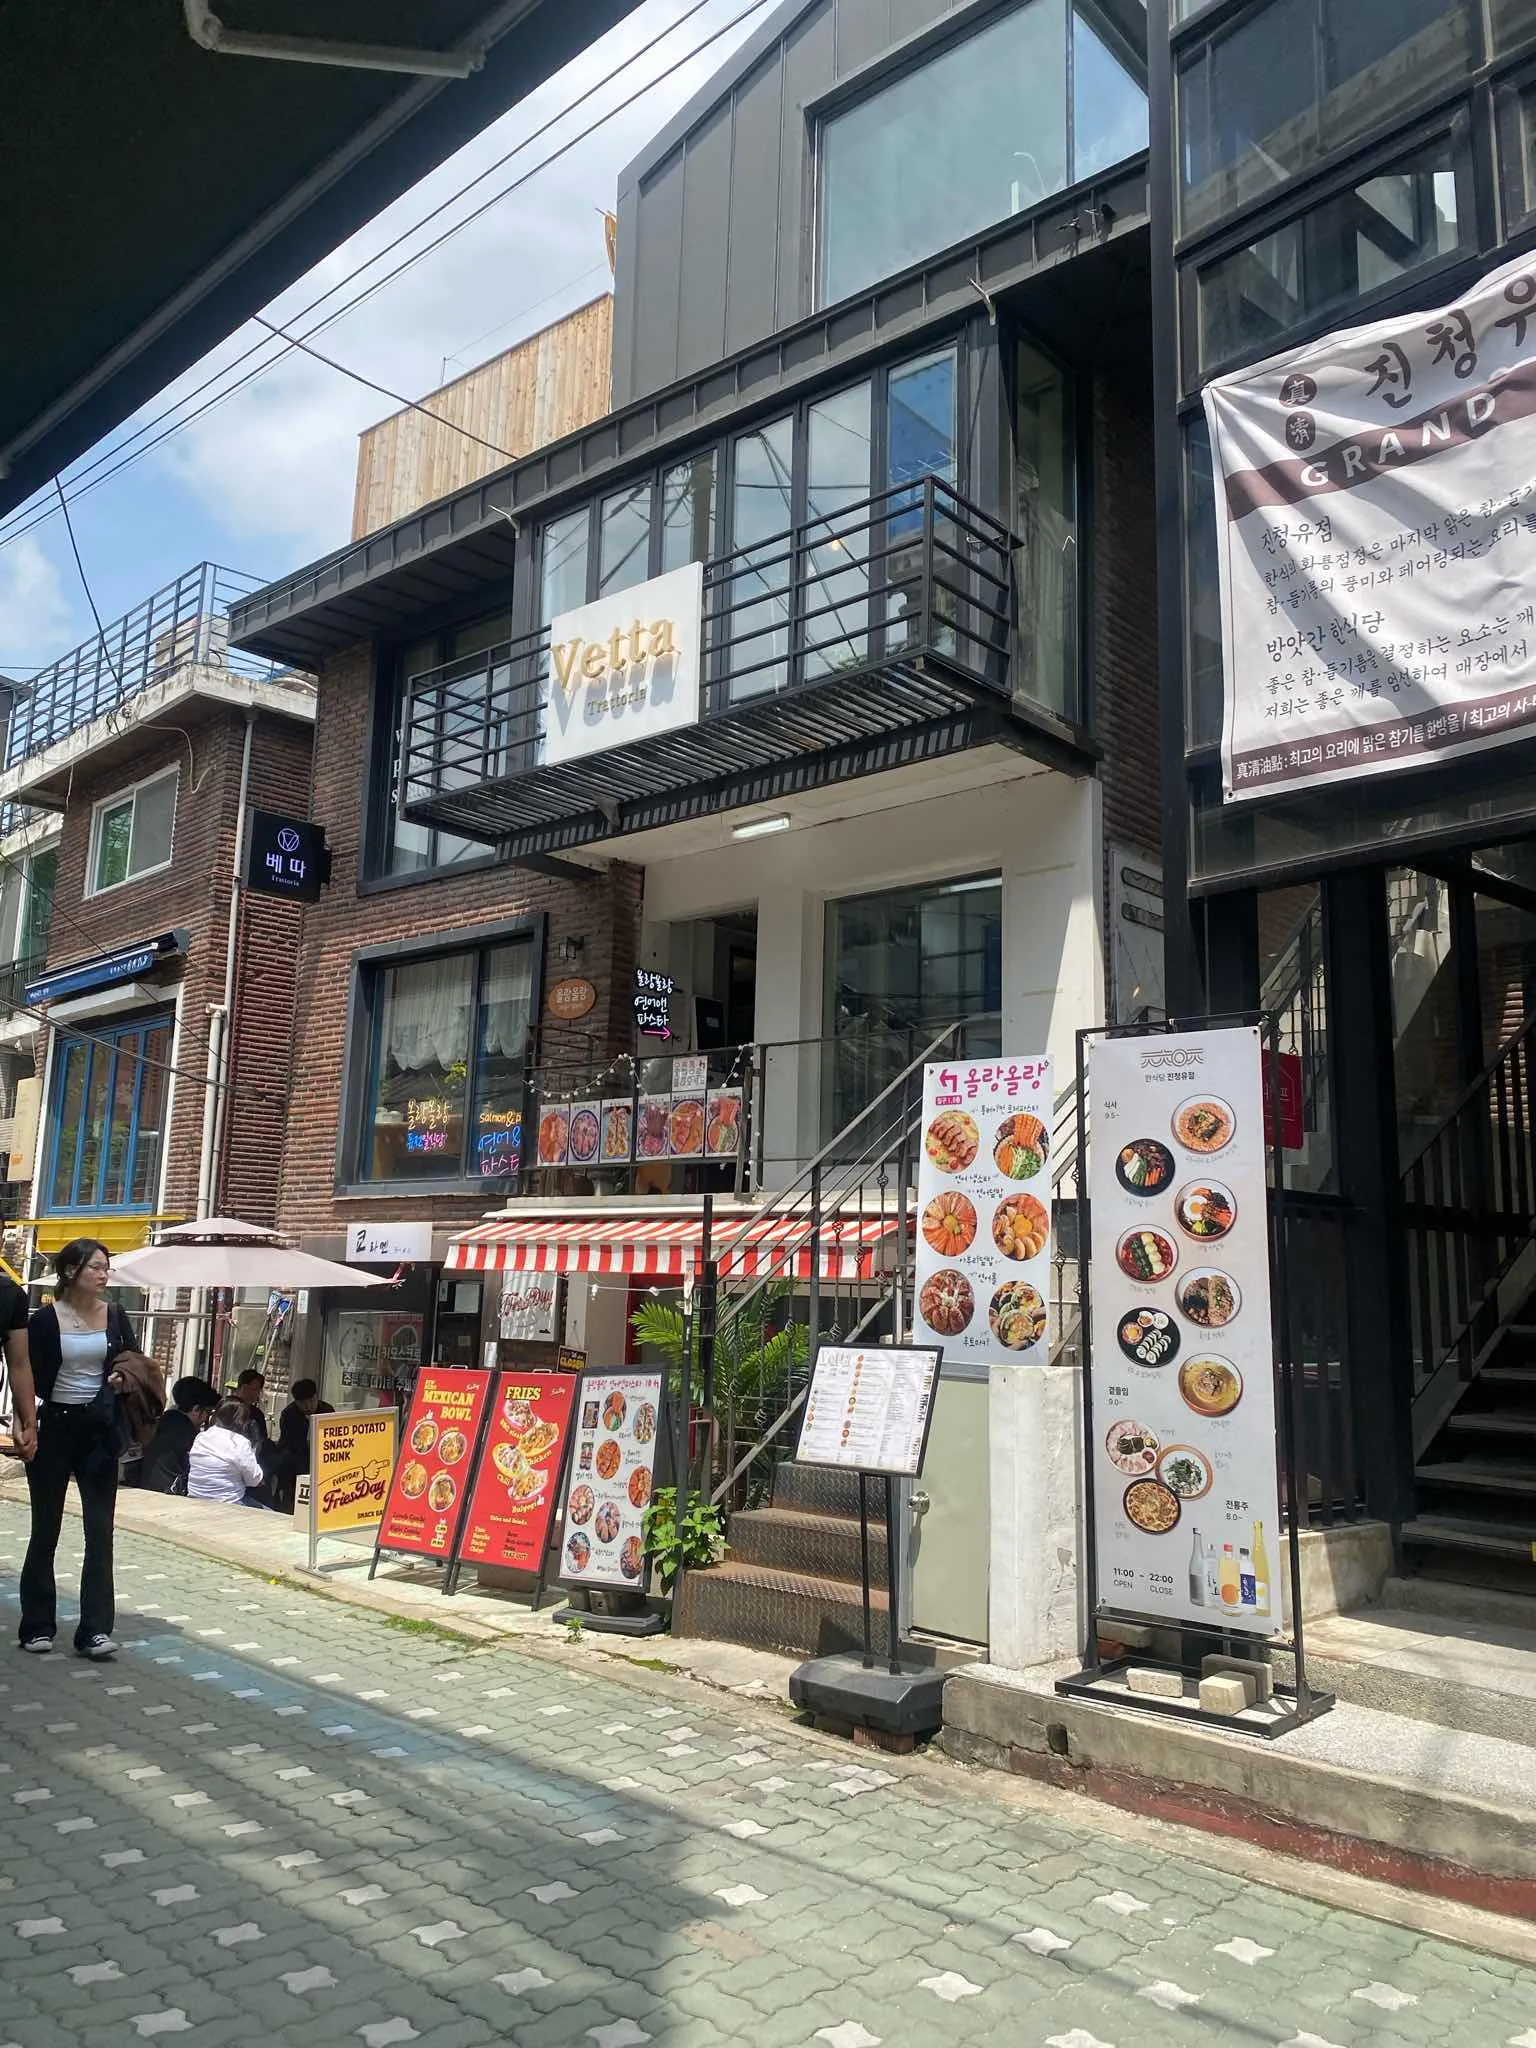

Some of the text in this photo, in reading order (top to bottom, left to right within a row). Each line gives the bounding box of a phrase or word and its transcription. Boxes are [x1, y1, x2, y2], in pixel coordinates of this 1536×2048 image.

[1300, 393, 1496, 486] GRAND
[1264, 560, 1297, 588] 한식의
[1389, 524, 1441, 553] 마지막
[1443, 508, 1472, 537] 맑은
[1341, 567, 1395, 594] 풍미와
[1398, 539, 1484, 579] 페어링되는
[1266, 611, 1386, 663] 방앗간 한식당
[550, 618, 683, 689] Vetta
[1265, 672, 1296, 695] 좋은
[1381, 632, 1451, 662] 결정하는
[1456, 616, 1511, 648] 요소는
[1264, 639, 1528, 721] 저희는 좋은 깨를 엄선하여 매장에서
[1289, 746, 1323, 768] 최고의
[1325, 739, 1360, 760] 요리에
[1362, 733, 1386, 754] 맑은
[1388, 725, 1424, 749] 참기름
[1426, 713, 1460, 741] 한방울
[1469, 702, 1511, 727] 최고의
[634, 995, 668, 1014] 연어앤
[637, 1013, 670, 1027] 파스타
[964, 1063, 1046, 1098] 올랑올랑
[422, 1390, 475, 1406] MEXICAN
[505, 1386, 542, 1401] FRIES
[440, 1406, 472, 1421] BOWL
[323, 1422, 386, 1438] FRIED POTATO
[323, 1438, 354, 1450] SNACK
[323, 1451, 351, 1463] DRINK
[332, 1471, 360, 1486] EVERYDAY
[1113, 1567, 1134, 1578] 11:00
[1149, 1572, 1174, 1584] 22:00
